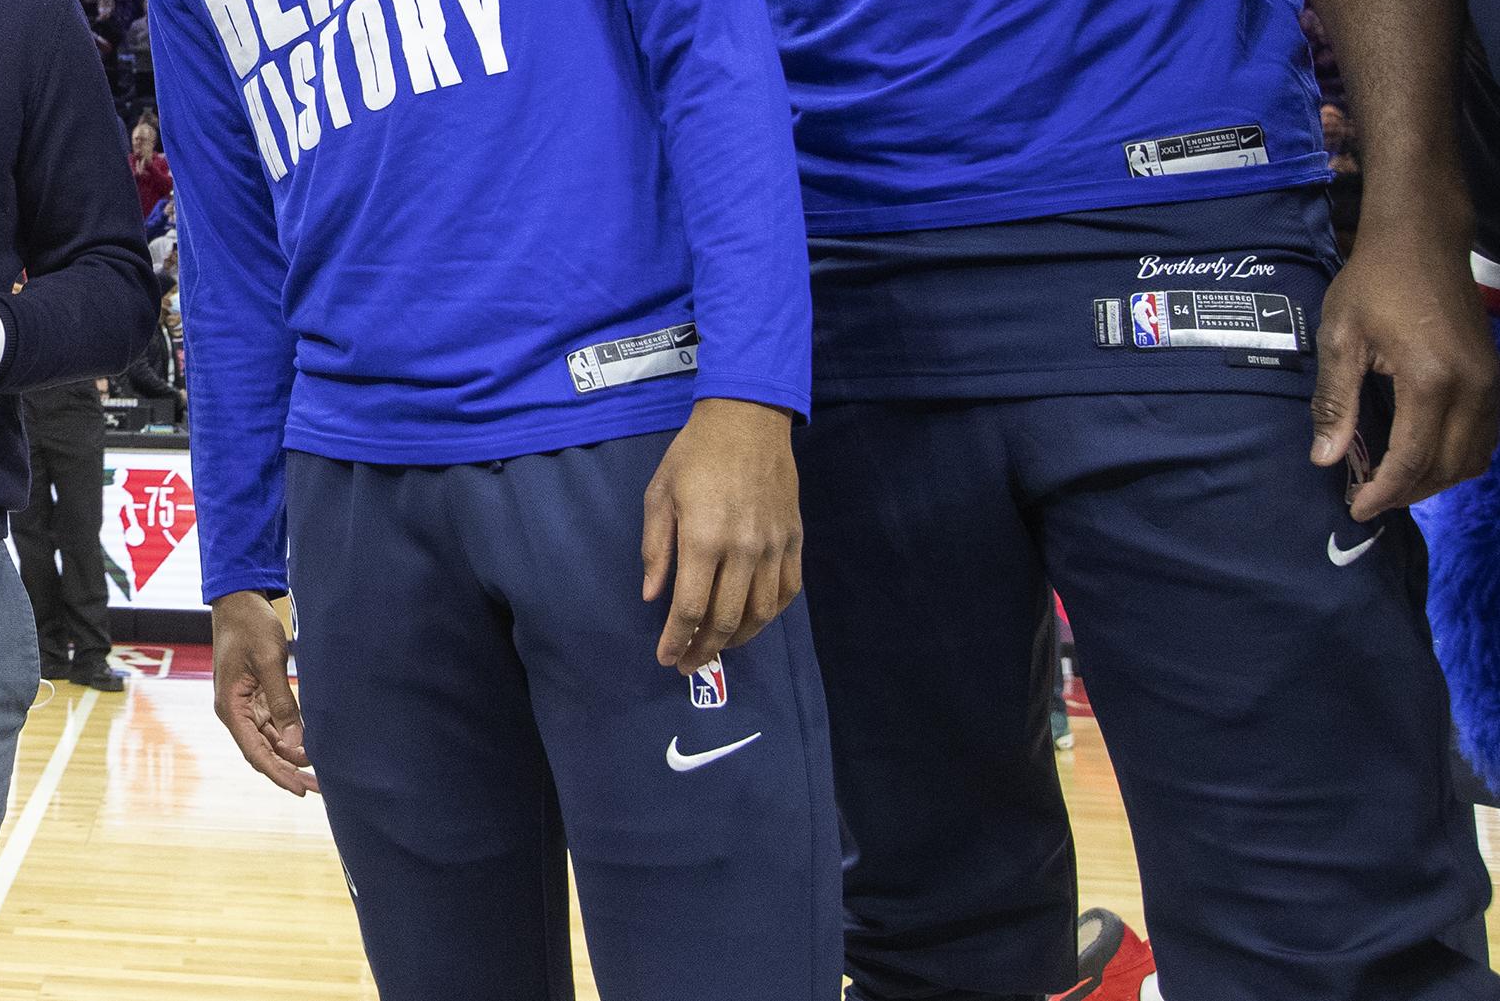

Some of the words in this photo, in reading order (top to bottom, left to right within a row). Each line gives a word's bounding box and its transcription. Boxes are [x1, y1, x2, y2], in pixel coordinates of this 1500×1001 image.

[1185, 133, 1236, 147] ENGINEERED
[1160, 145, 1182, 155] XXLT
[1137, 254, 1233, 281] Brotherly
[1230, 255, 1276, 277] Love
[1196, 294, 1252, 302] ENGINEERED
[1173, 304, 1190, 316] 54
[620, 334, 668, 350] ENGINEERED
[1136, 332, 1149, 346] 75
[603, 349, 613, 359] L
[679, 350, 693, 366] 0
[143, 486, 175, 529] 75
[695, 685, 713, 706] 75
